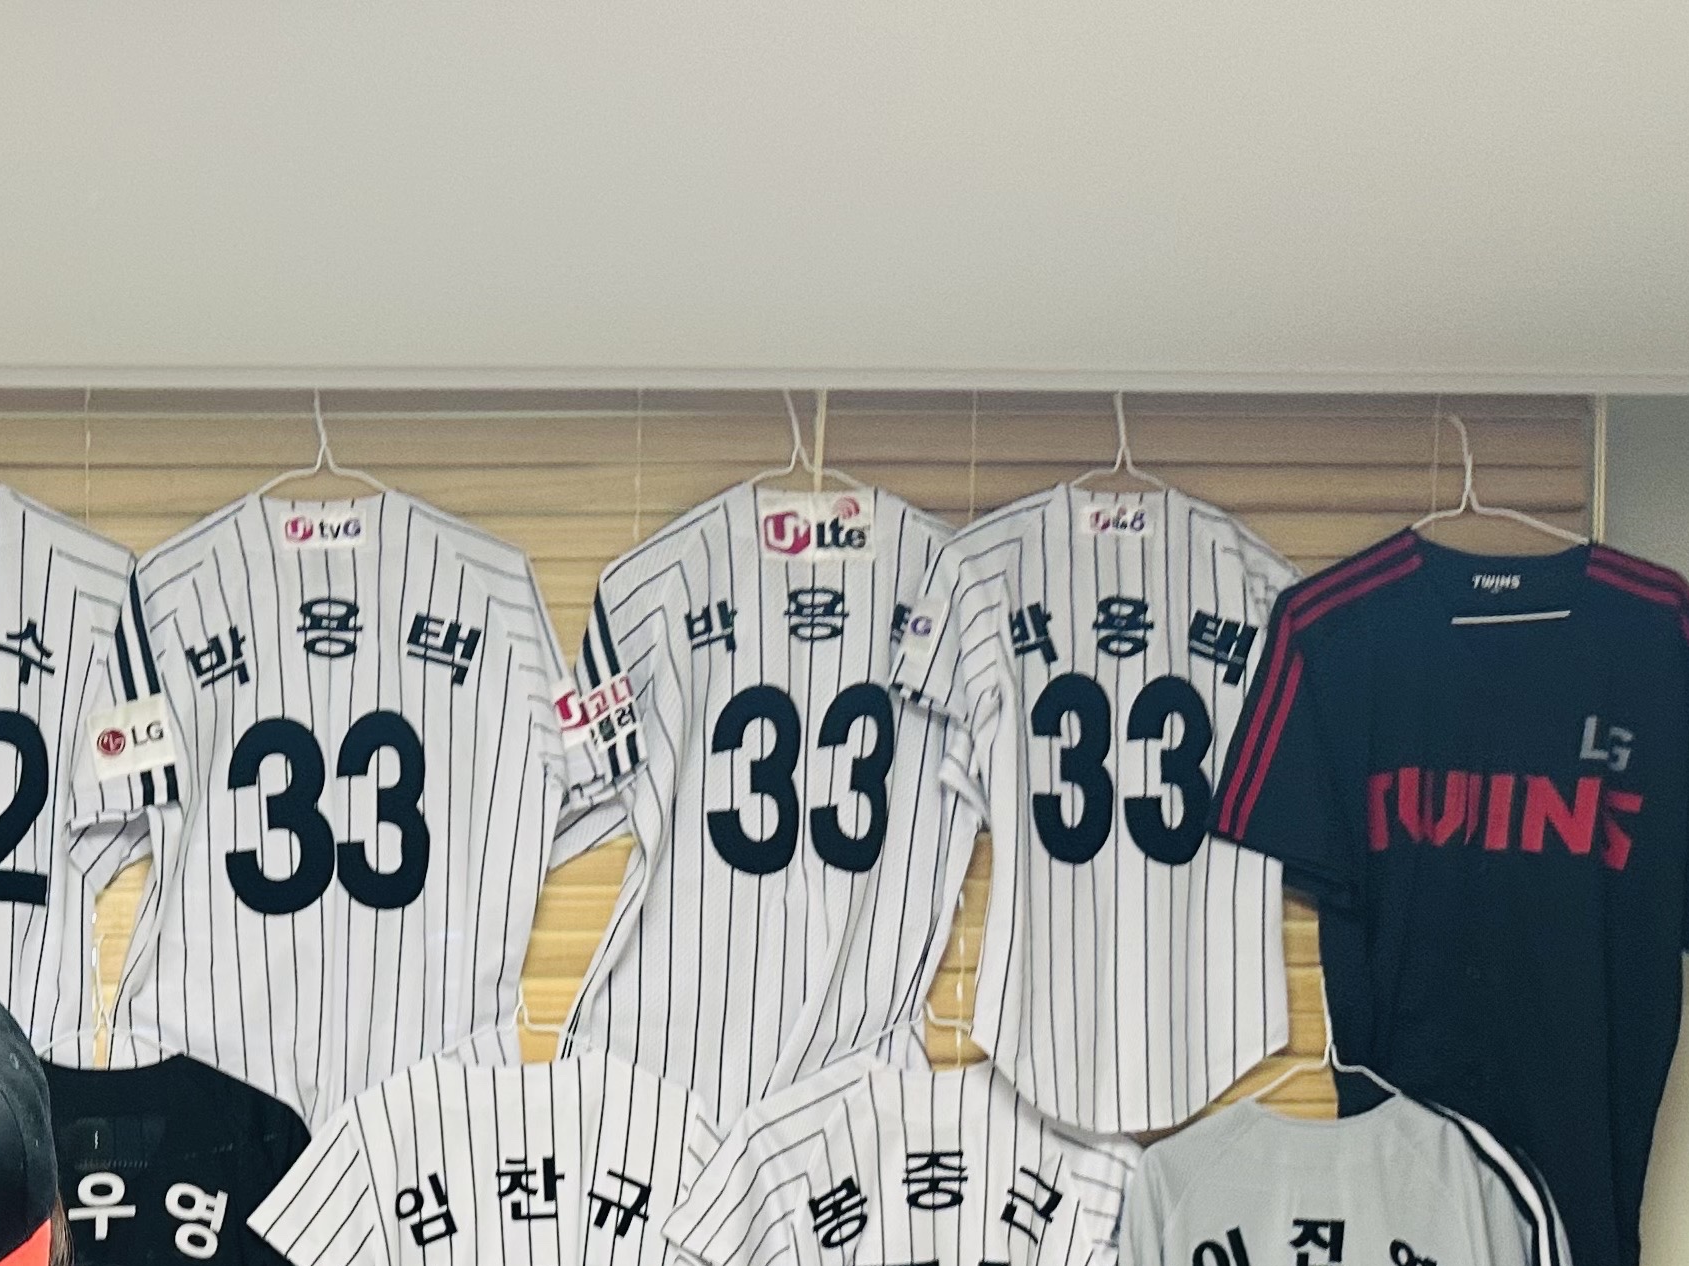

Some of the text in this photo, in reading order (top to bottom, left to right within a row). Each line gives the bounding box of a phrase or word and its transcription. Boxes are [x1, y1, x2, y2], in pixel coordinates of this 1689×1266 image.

[187, 596, 482, 688] 박용택
[131, 720, 165, 747] LG
[707, 682, 895, 875] 33
[1030, 672, 1213, 866] 33
[1579, 714, 1635, 772] LG
[225, 709, 431, 916] 33
[395, 1155, 653, 1246] 임찬규
